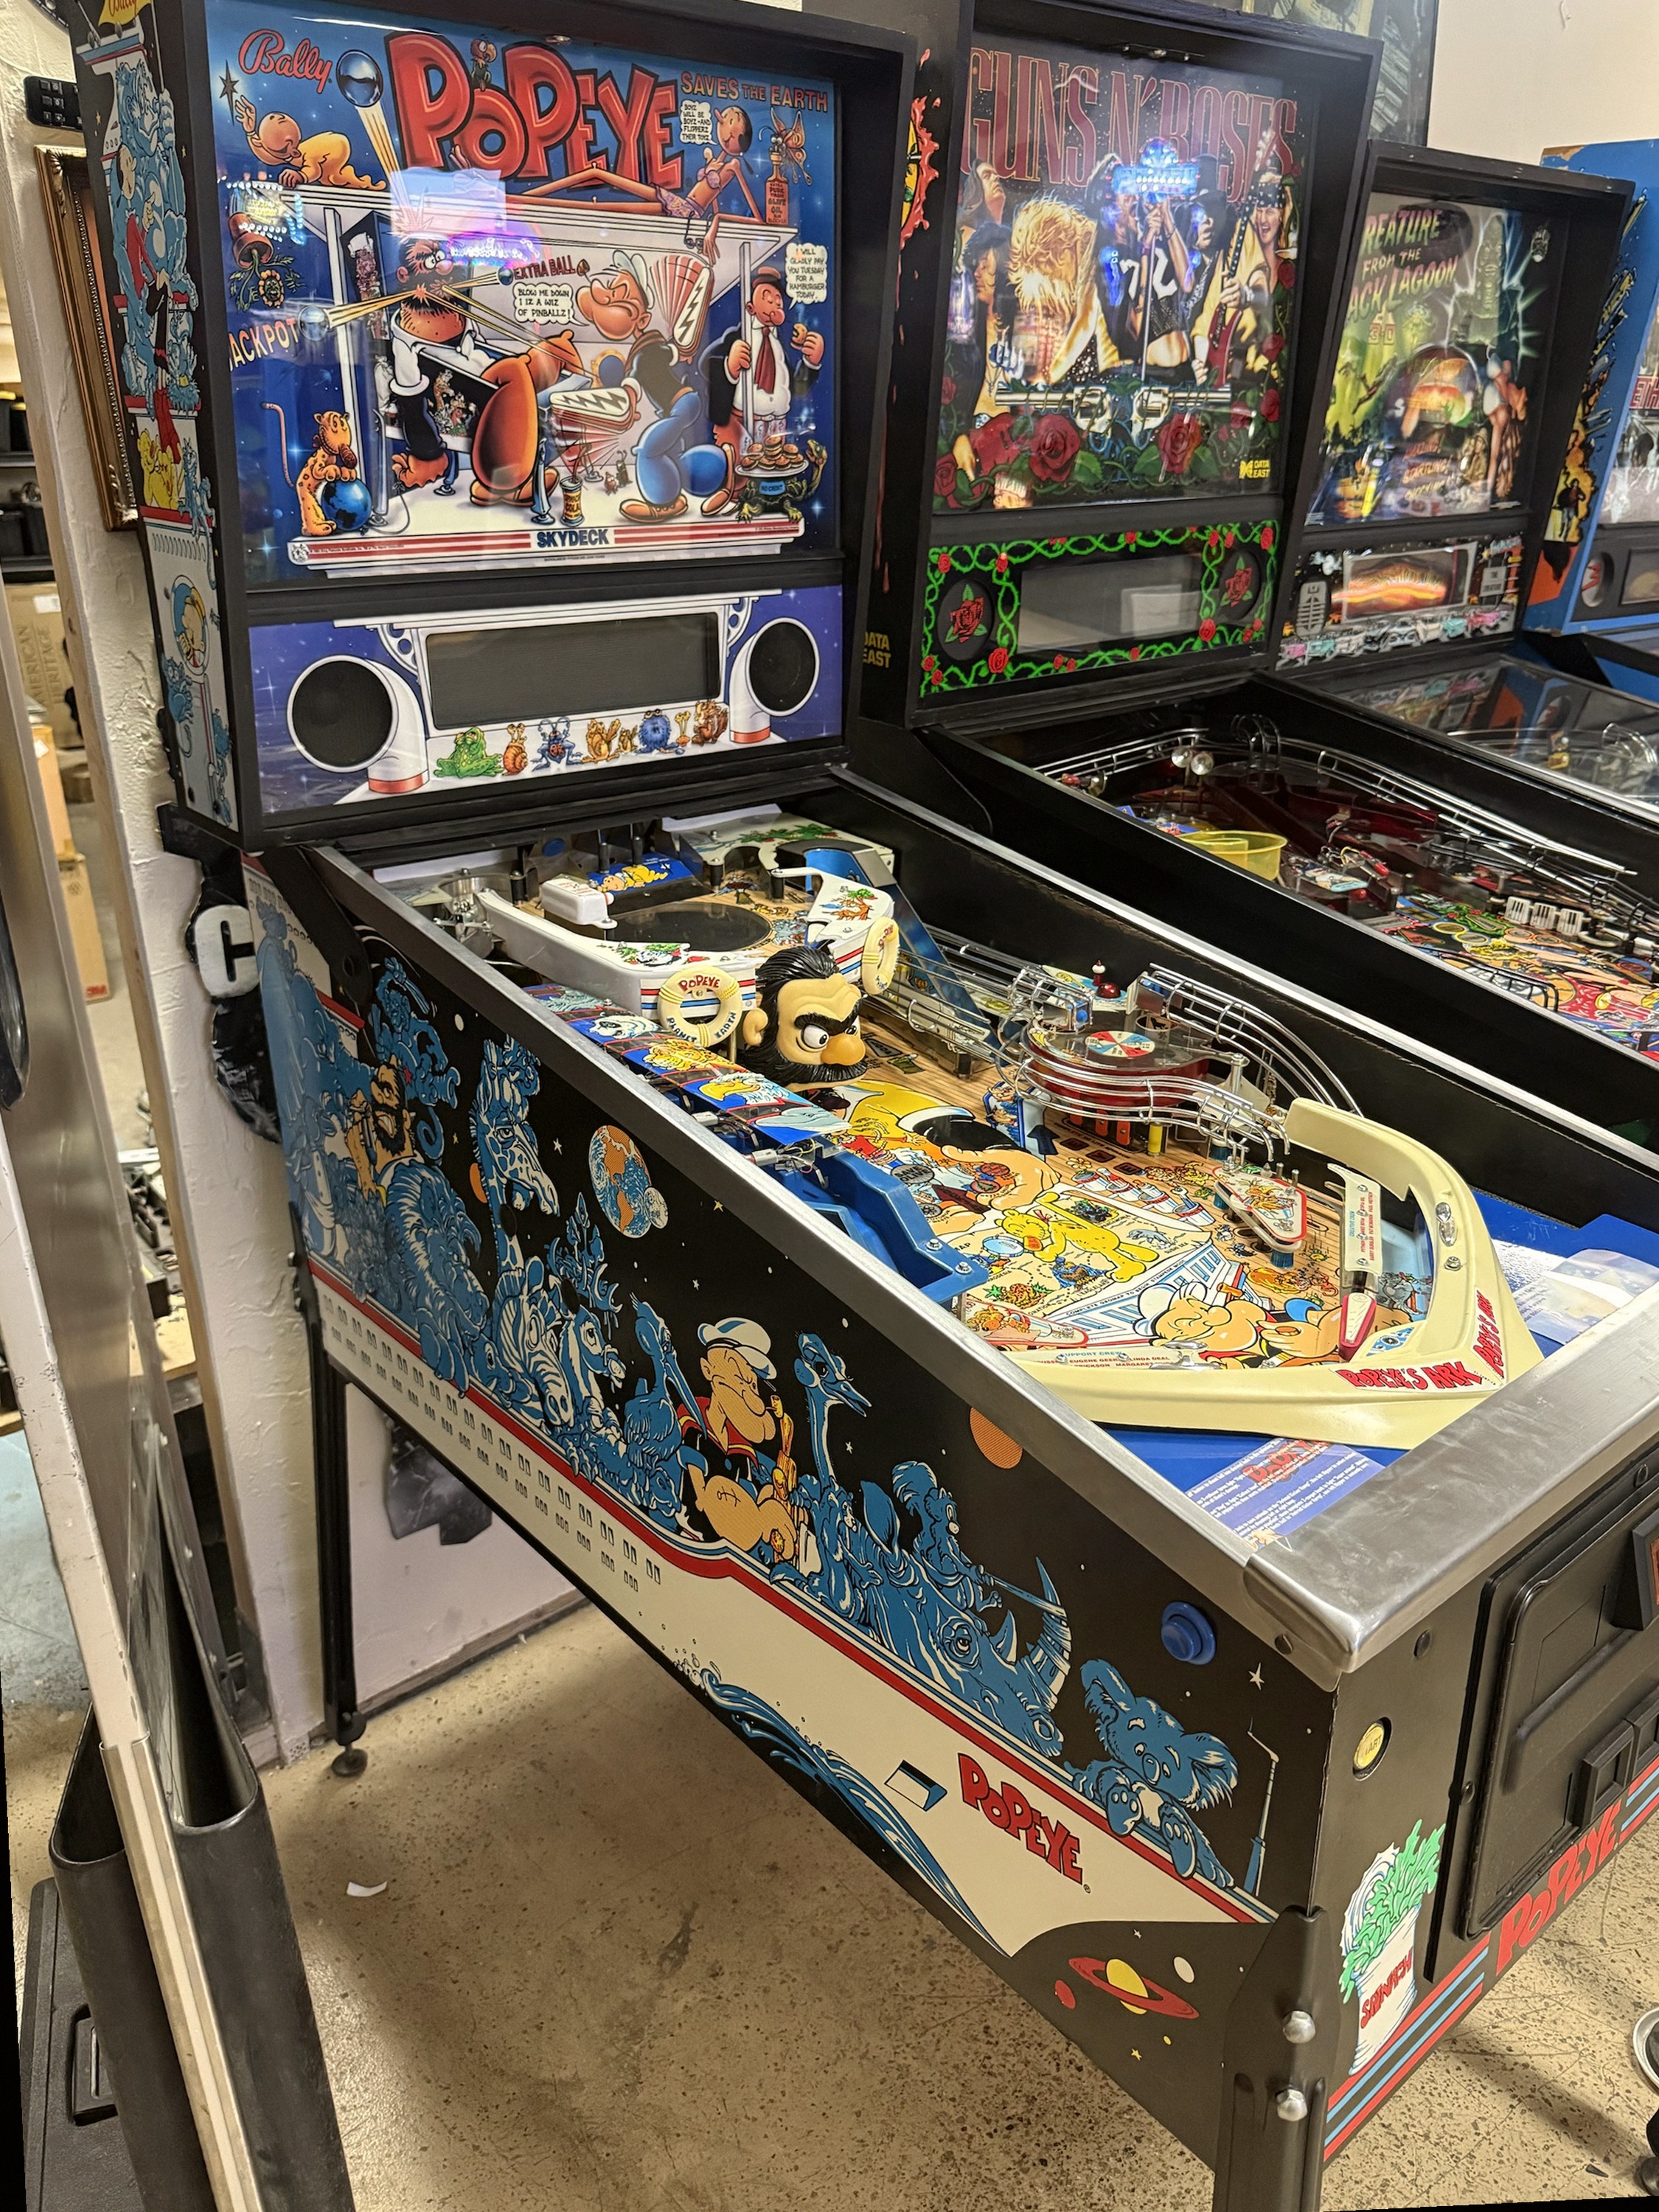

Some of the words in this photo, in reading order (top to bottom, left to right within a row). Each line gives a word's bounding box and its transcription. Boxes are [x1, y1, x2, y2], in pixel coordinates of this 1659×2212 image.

[238, 29, 333, 94] Bally
[384, 30, 684, 190] POPEYE
[681, 72, 740, 100] SAVES
[742, 83, 766, 101] THE
[770, 85, 828, 112] EARTH
[961, 47, 1099, 188] GUNS
[1159, 78, 1298, 204] ROSES
[1361, 208, 1443, 254] REATURE
[513, 261, 549, 279] EXTRA
[548, 255, 576, 276] BALL
[1362, 253, 1395, 280] FROM
[1399, 248, 1422, 265] THE
[1348, 274, 1388, 323] ACK
[1386, 255, 1458, 310] LAGOON
[1253, 470, 1270, 478] EAST
[1254, 460, 1270, 468] DATA
[537, 529, 610, 548] SKYDECK
[678, 975, 720, 992] POPEYE
[667, 1017, 698, 1043] PLANET
[714, 1012, 737, 1039] EARTH
[1066, 1303, 1099, 1315] COMPLETE
[1151, 1268, 1174, 1285] STAMPEDE
[1477, 1290, 1498, 1324] ARK
[1473, 1315, 1505, 1379] POPEYE'S
[1335, 1367, 1428, 1390] POPEYE'S
[1421, 1361, 1483, 1389] ARK
[958, 1752, 1083, 1885] POPEYE
[1495, 1798, 1621, 1976] POPEYE
[1360, 1948, 1413, 2028] SPINACH
